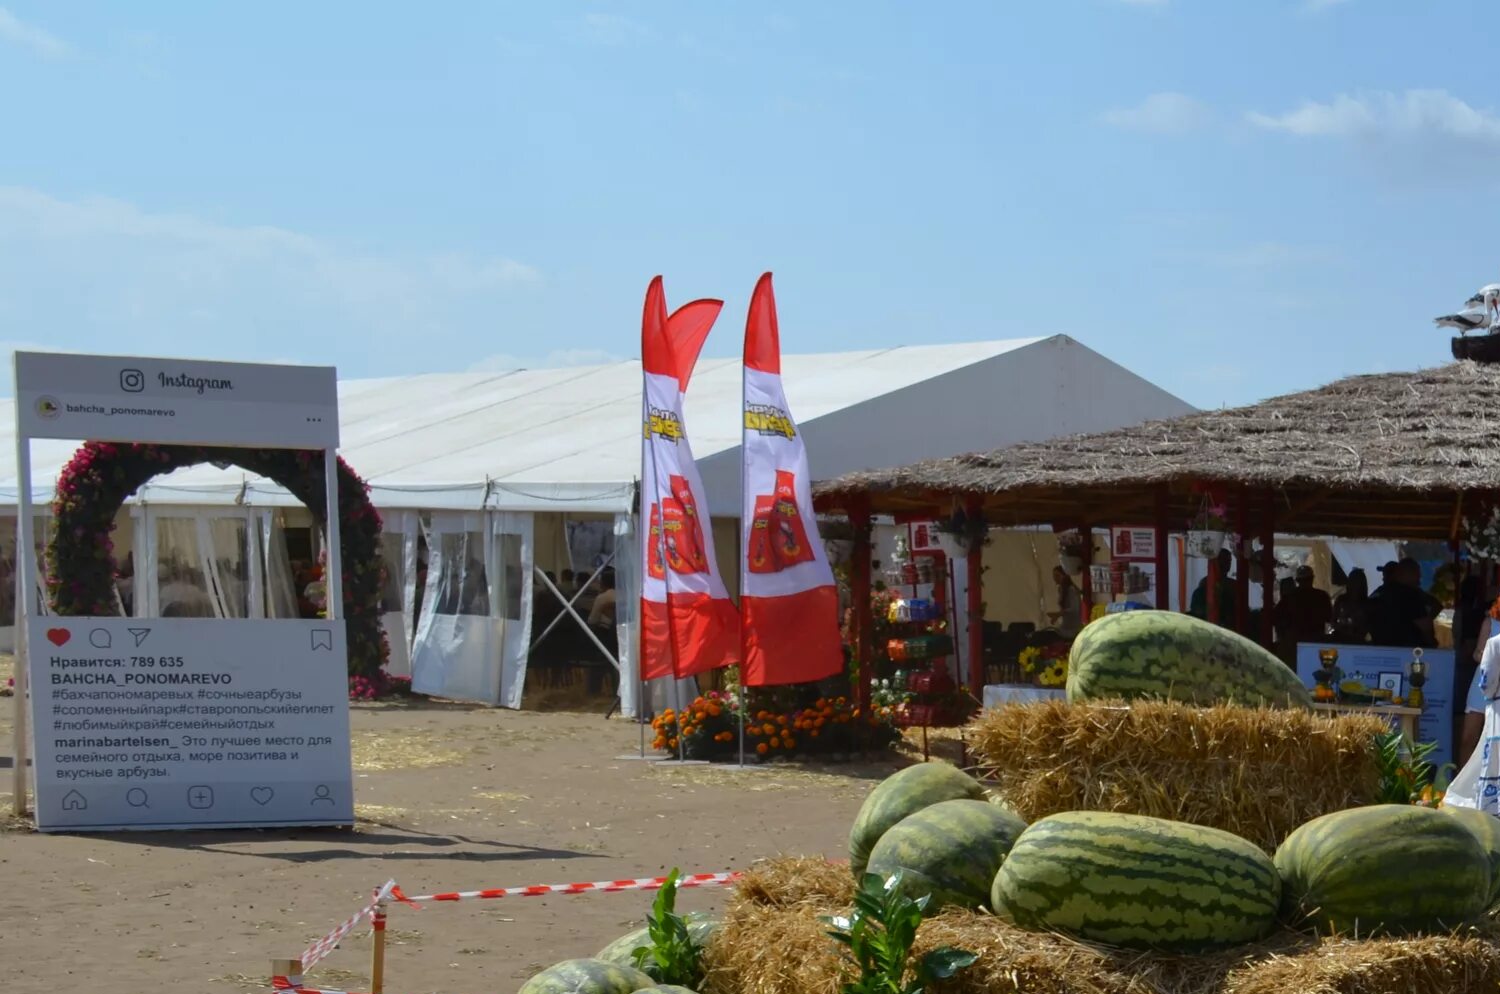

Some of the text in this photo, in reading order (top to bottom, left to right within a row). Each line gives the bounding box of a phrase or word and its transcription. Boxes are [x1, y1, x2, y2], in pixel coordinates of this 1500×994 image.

[158, 371, 234, 394] Instagram
[66, 403, 176, 417] bahcha_ponomarevo
[50, 656, 184, 669] Нравится: 789 635
[51, 673, 232, 687] BAHCHA_PONOMAREVO
[52, 688, 302, 702] #бахчапономаревых #сочныеарбузы
[54, 718, 275, 731] #любимыйкрай#семейныйотдых
[182, 735, 207, 747] Это
[210, 736, 261, 749] лучшее
[265, 736, 304, 746] место
[307, 736, 332, 747] для
[55, 751, 299, 763] семейного отдыха, море позитива и
[56, 765, 170, 780] вкусные арбузы.
